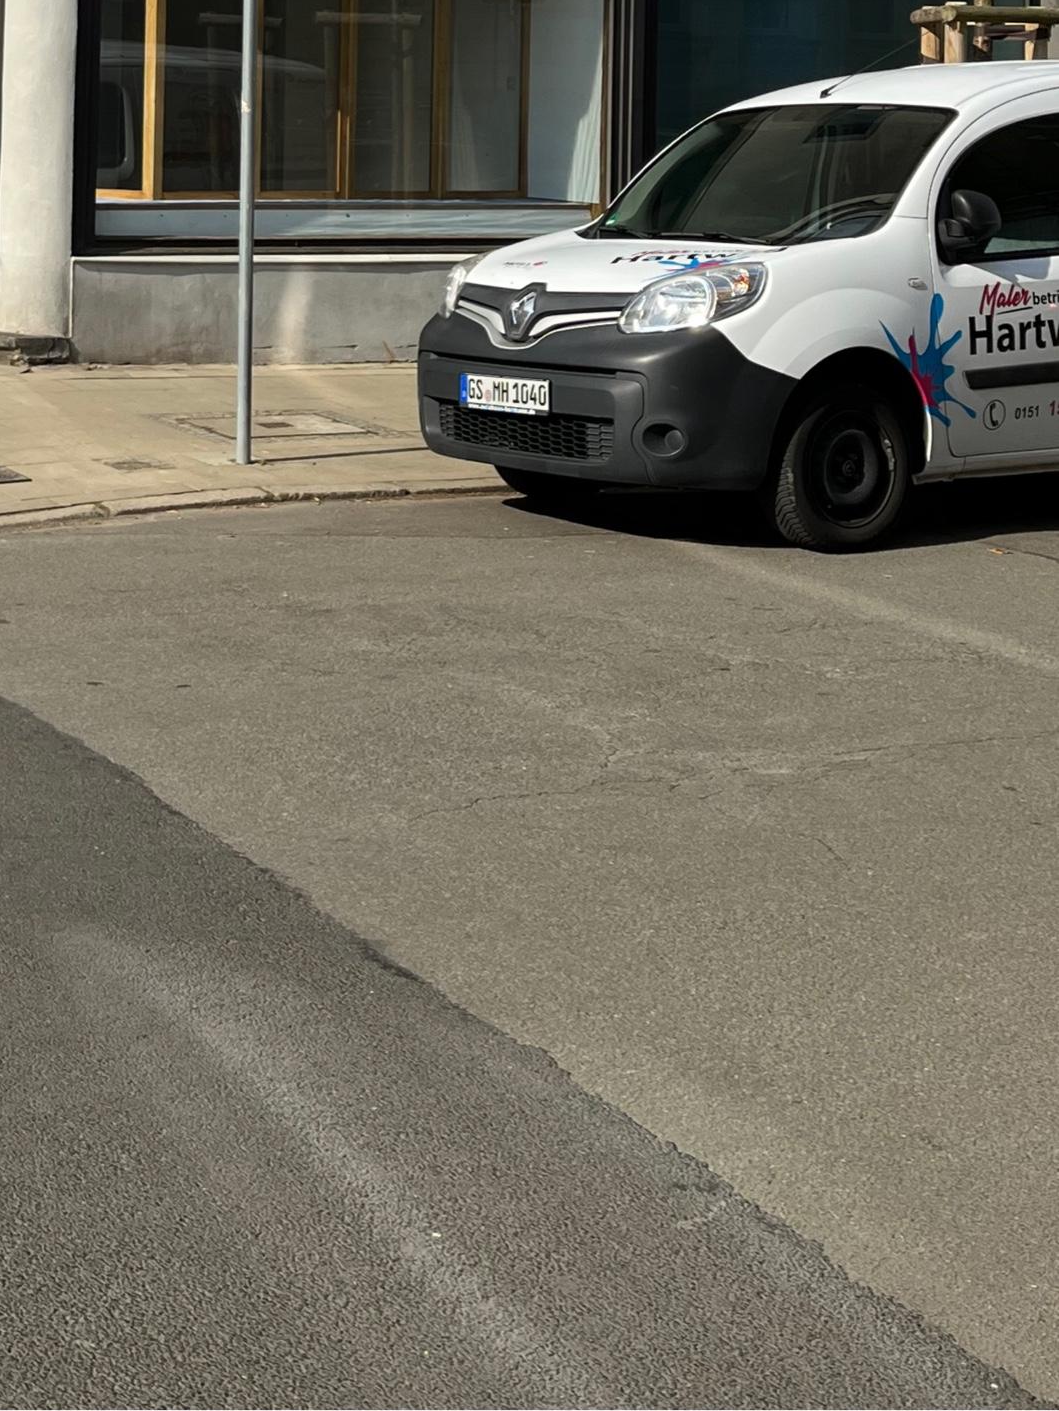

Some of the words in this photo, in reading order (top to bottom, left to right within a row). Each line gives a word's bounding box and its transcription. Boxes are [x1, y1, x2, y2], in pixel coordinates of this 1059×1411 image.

[979, 281, 1031, 317] Maler
[468, 378, 483, 400] GS
[493, 381, 509, 403] MH
[512, 382, 547, 406] 1040
[1014, 404, 1039, 420] 0151
